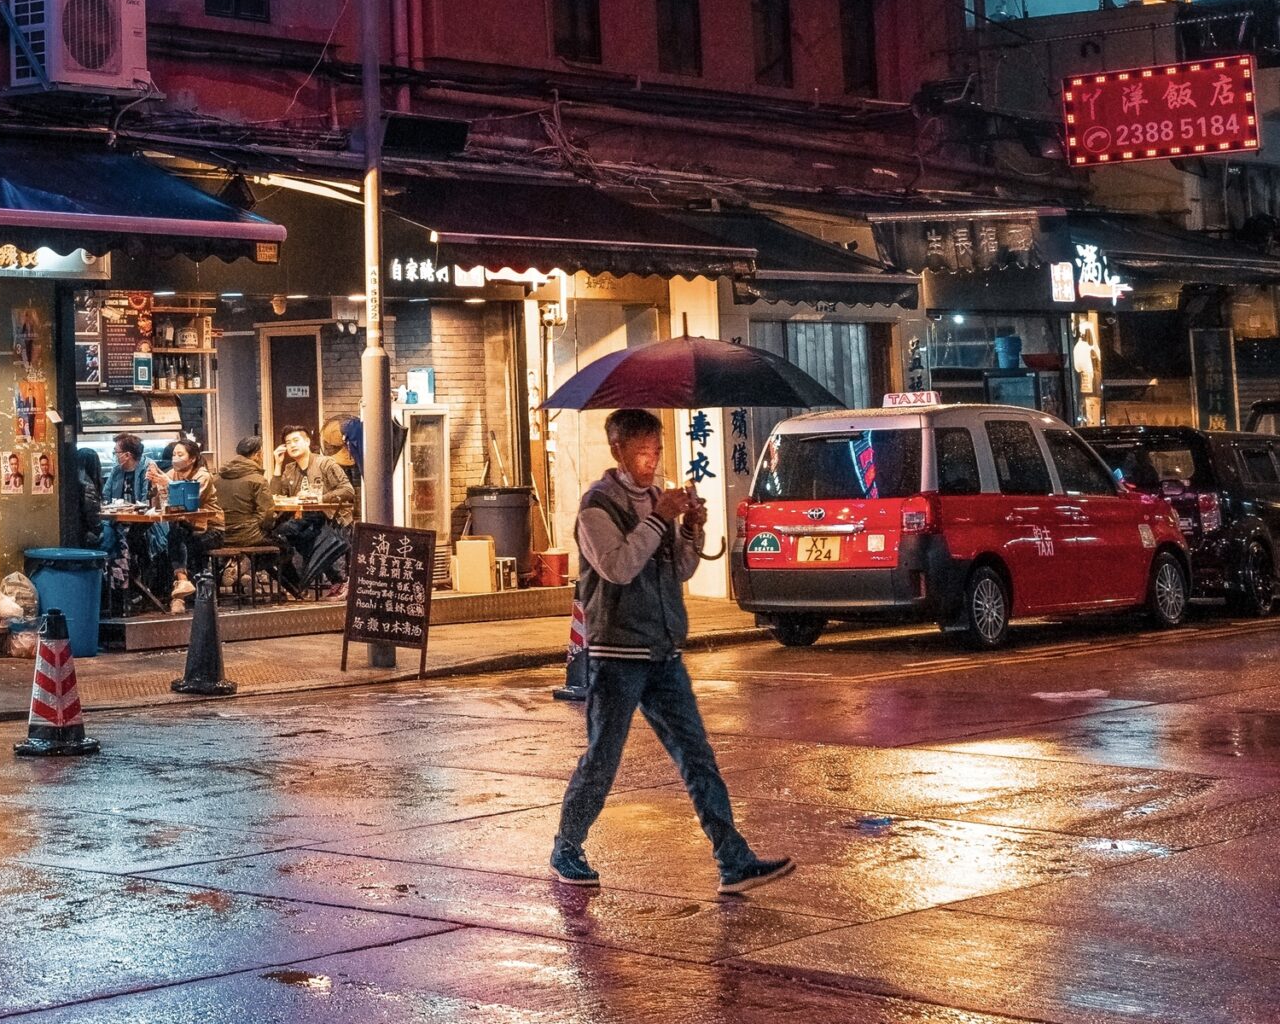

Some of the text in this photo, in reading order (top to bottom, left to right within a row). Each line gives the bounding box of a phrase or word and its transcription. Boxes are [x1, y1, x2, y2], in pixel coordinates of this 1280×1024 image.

[1116, 113, 1240, 146] 2388 5184
[888, 393, 932, 405] TAXI
[685, 411, 716, 483] 壽衣
[1033, 525, 1052, 540] 的士
[761, 539, 768, 547] 4
[811, 538, 828, 549] XT
[1036, 541, 1054, 556] TAXI
[805, 549, 832, 561] 724
